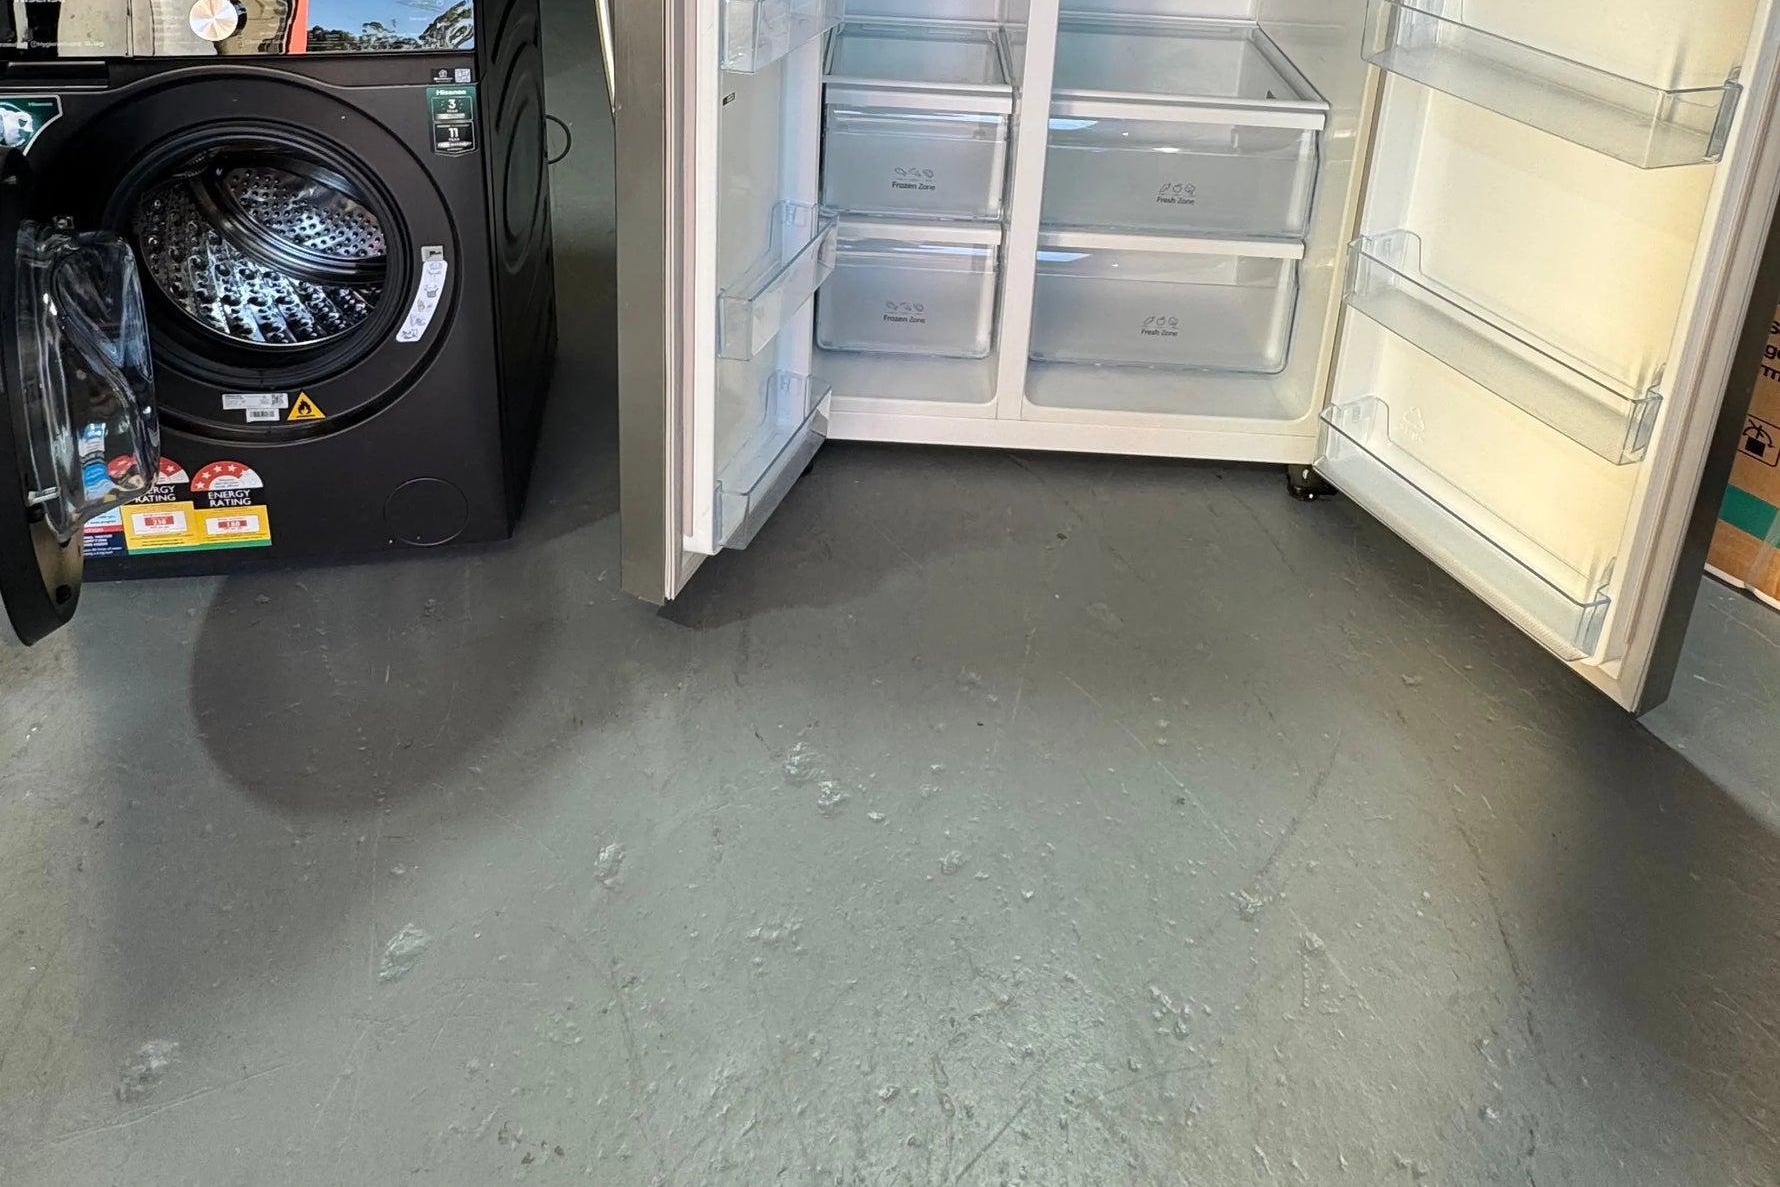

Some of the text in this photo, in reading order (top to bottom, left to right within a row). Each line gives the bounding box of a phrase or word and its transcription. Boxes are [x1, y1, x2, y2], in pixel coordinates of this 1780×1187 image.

[448, 99, 457, 109] 3
[448, 127, 459, 138] 11
[891, 180, 936, 192] Frozen Zone
[1156, 195, 1196, 206] Fresh Zone
[882, 313, 926, 325] Frozen Zone
[1141, 327, 1179, 338] Fresh Zone
[134, 494, 176, 503] RATING
[207, 489, 251, 500] ENERGY
[209, 497, 252, 508] RATING
